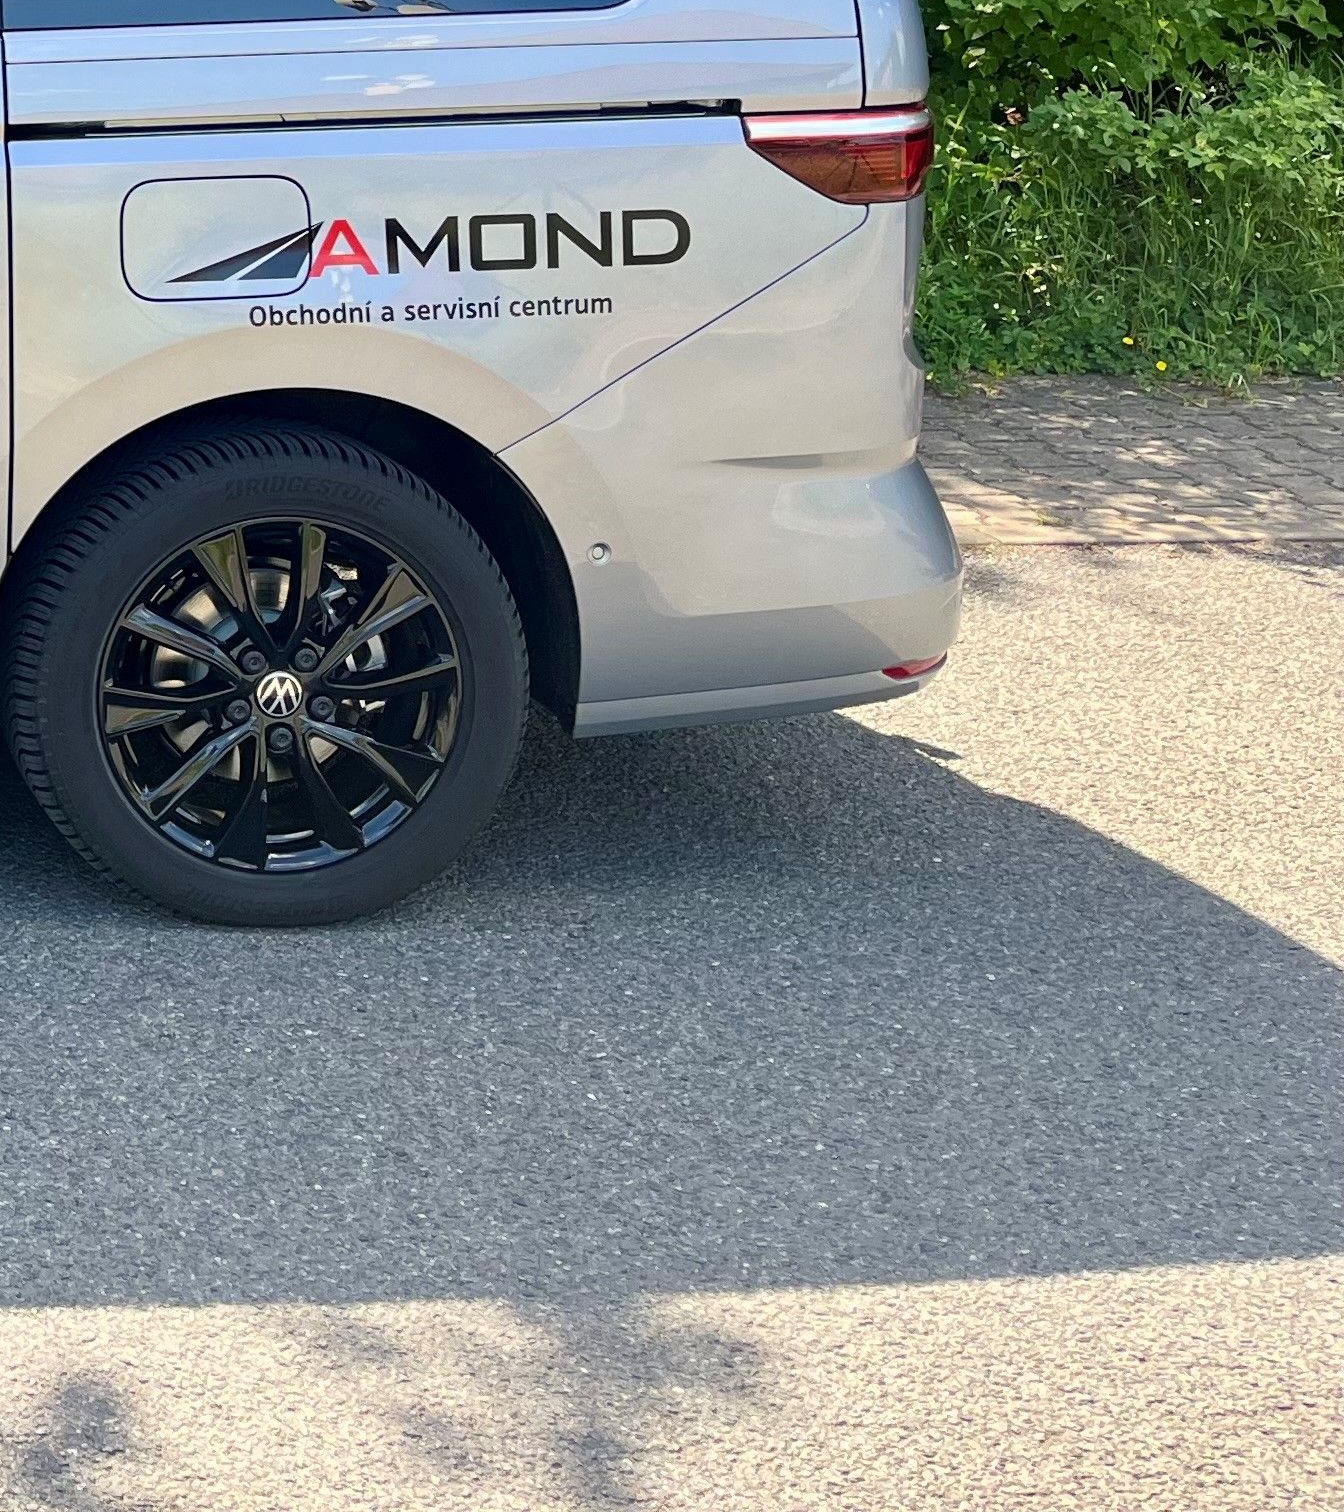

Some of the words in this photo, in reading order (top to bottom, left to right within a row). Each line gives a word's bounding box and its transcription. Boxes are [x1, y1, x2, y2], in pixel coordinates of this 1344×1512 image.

[308, 209, 691, 276] AMOND
[248, 300, 372, 328] Obchodní
[380, 305, 395, 322] a
[405, 296, 501, 322] servisní
[510, 296, 613, 318] centrum
